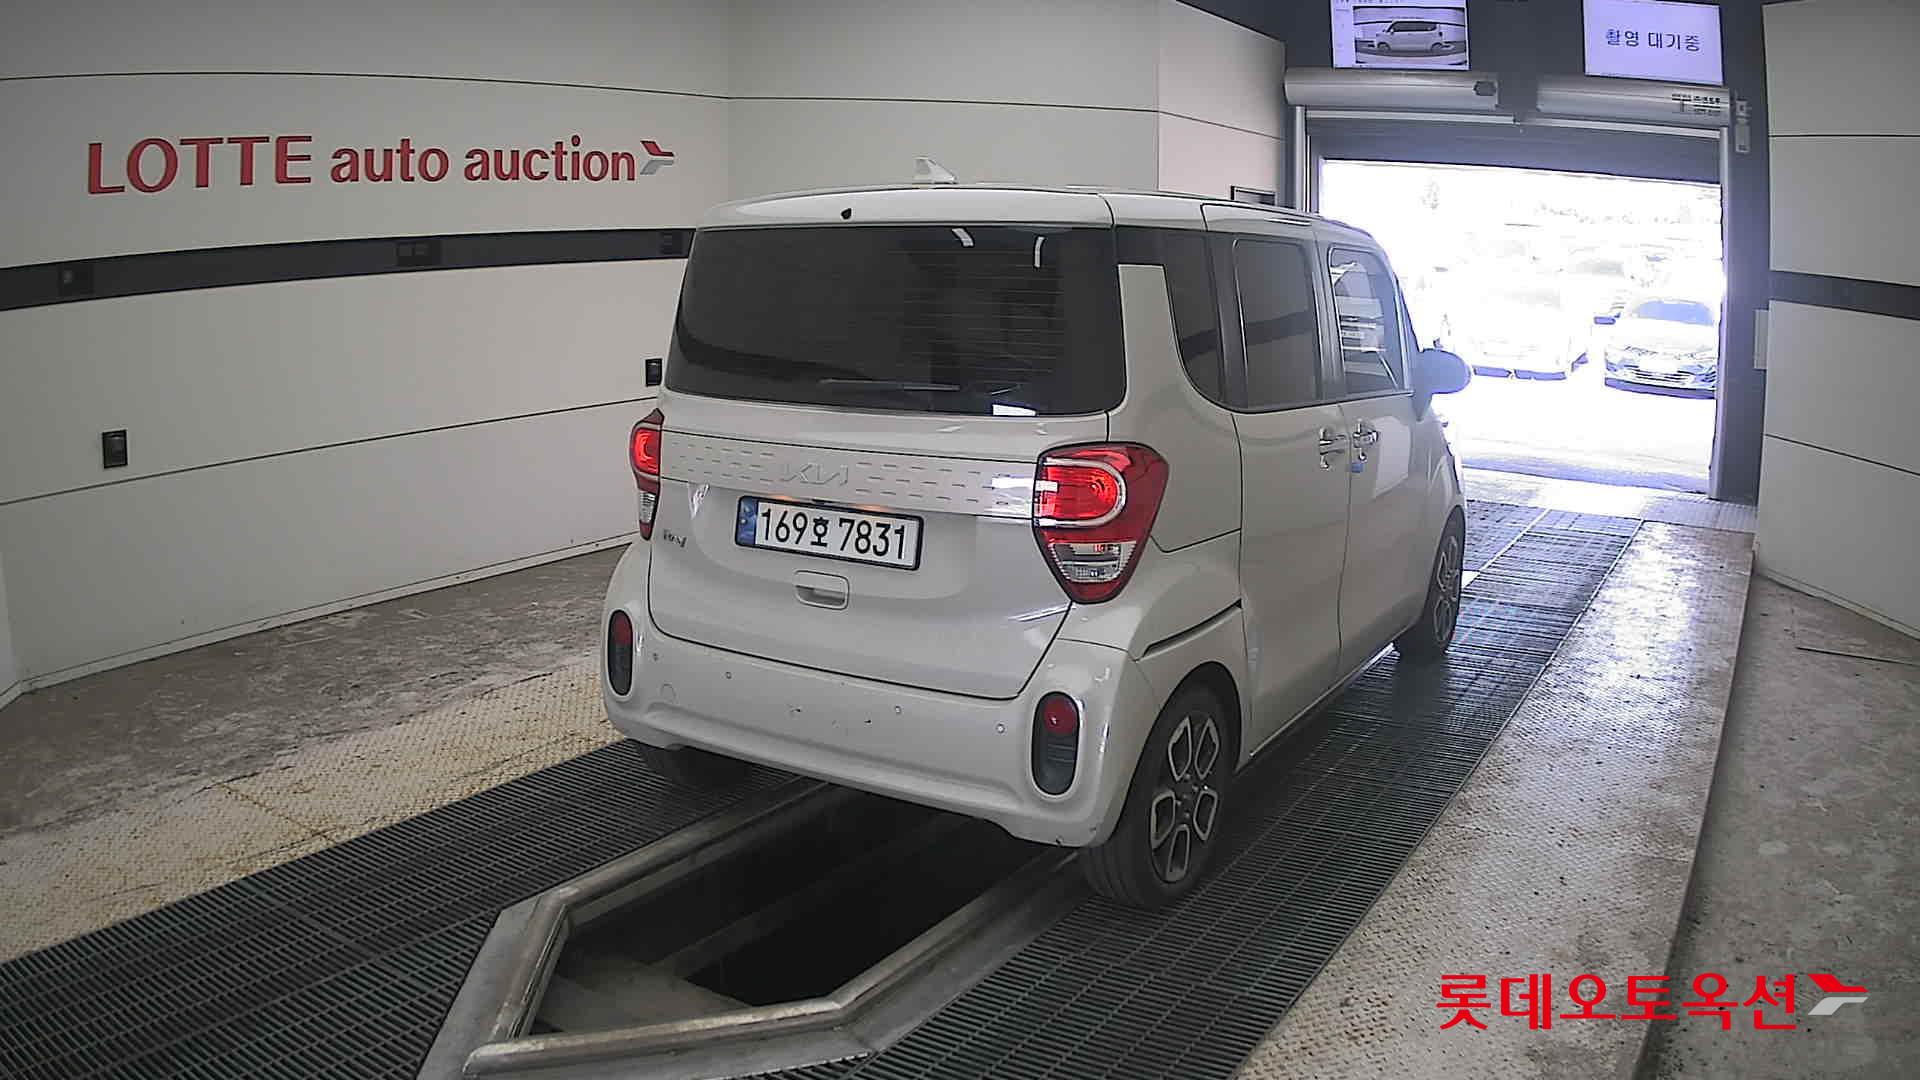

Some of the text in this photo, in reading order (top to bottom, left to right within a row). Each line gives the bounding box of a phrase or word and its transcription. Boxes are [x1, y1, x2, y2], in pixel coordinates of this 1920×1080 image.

[1648, 32, 1701, 52] 대기중
[87, 135, 636, 195] LOTTE auto auction
[760, 508, 906, 560] 169호 7831
